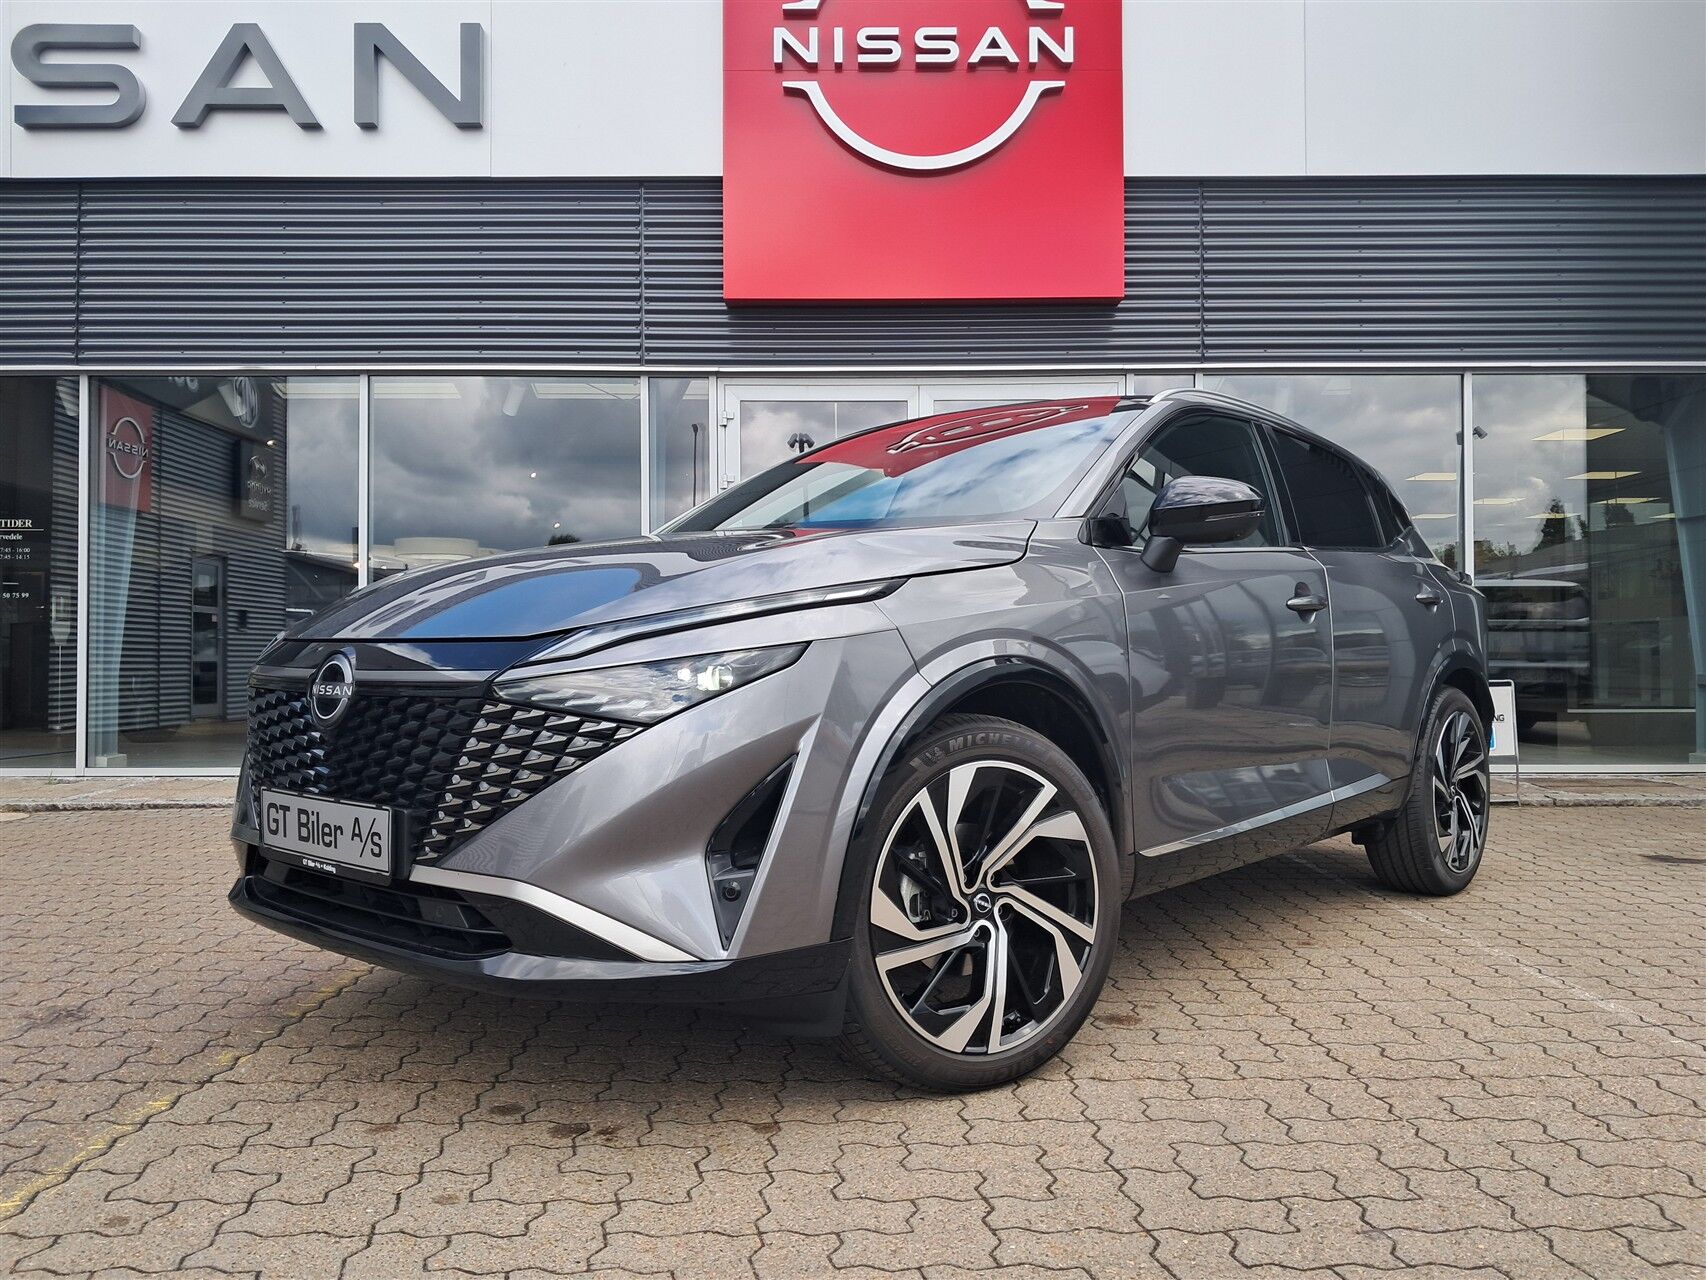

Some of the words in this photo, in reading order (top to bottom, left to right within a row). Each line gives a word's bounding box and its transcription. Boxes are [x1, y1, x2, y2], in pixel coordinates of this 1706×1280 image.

[773, 26, 1074, 69] NISSAN
[10, 22, 485, 130] SAN
[0, 519, 33, 528] TIDER
[312, 684, 353, 696] NISSAN
[267, 802, 291, 838] GT
[297, 808, 344, 849] Biler
